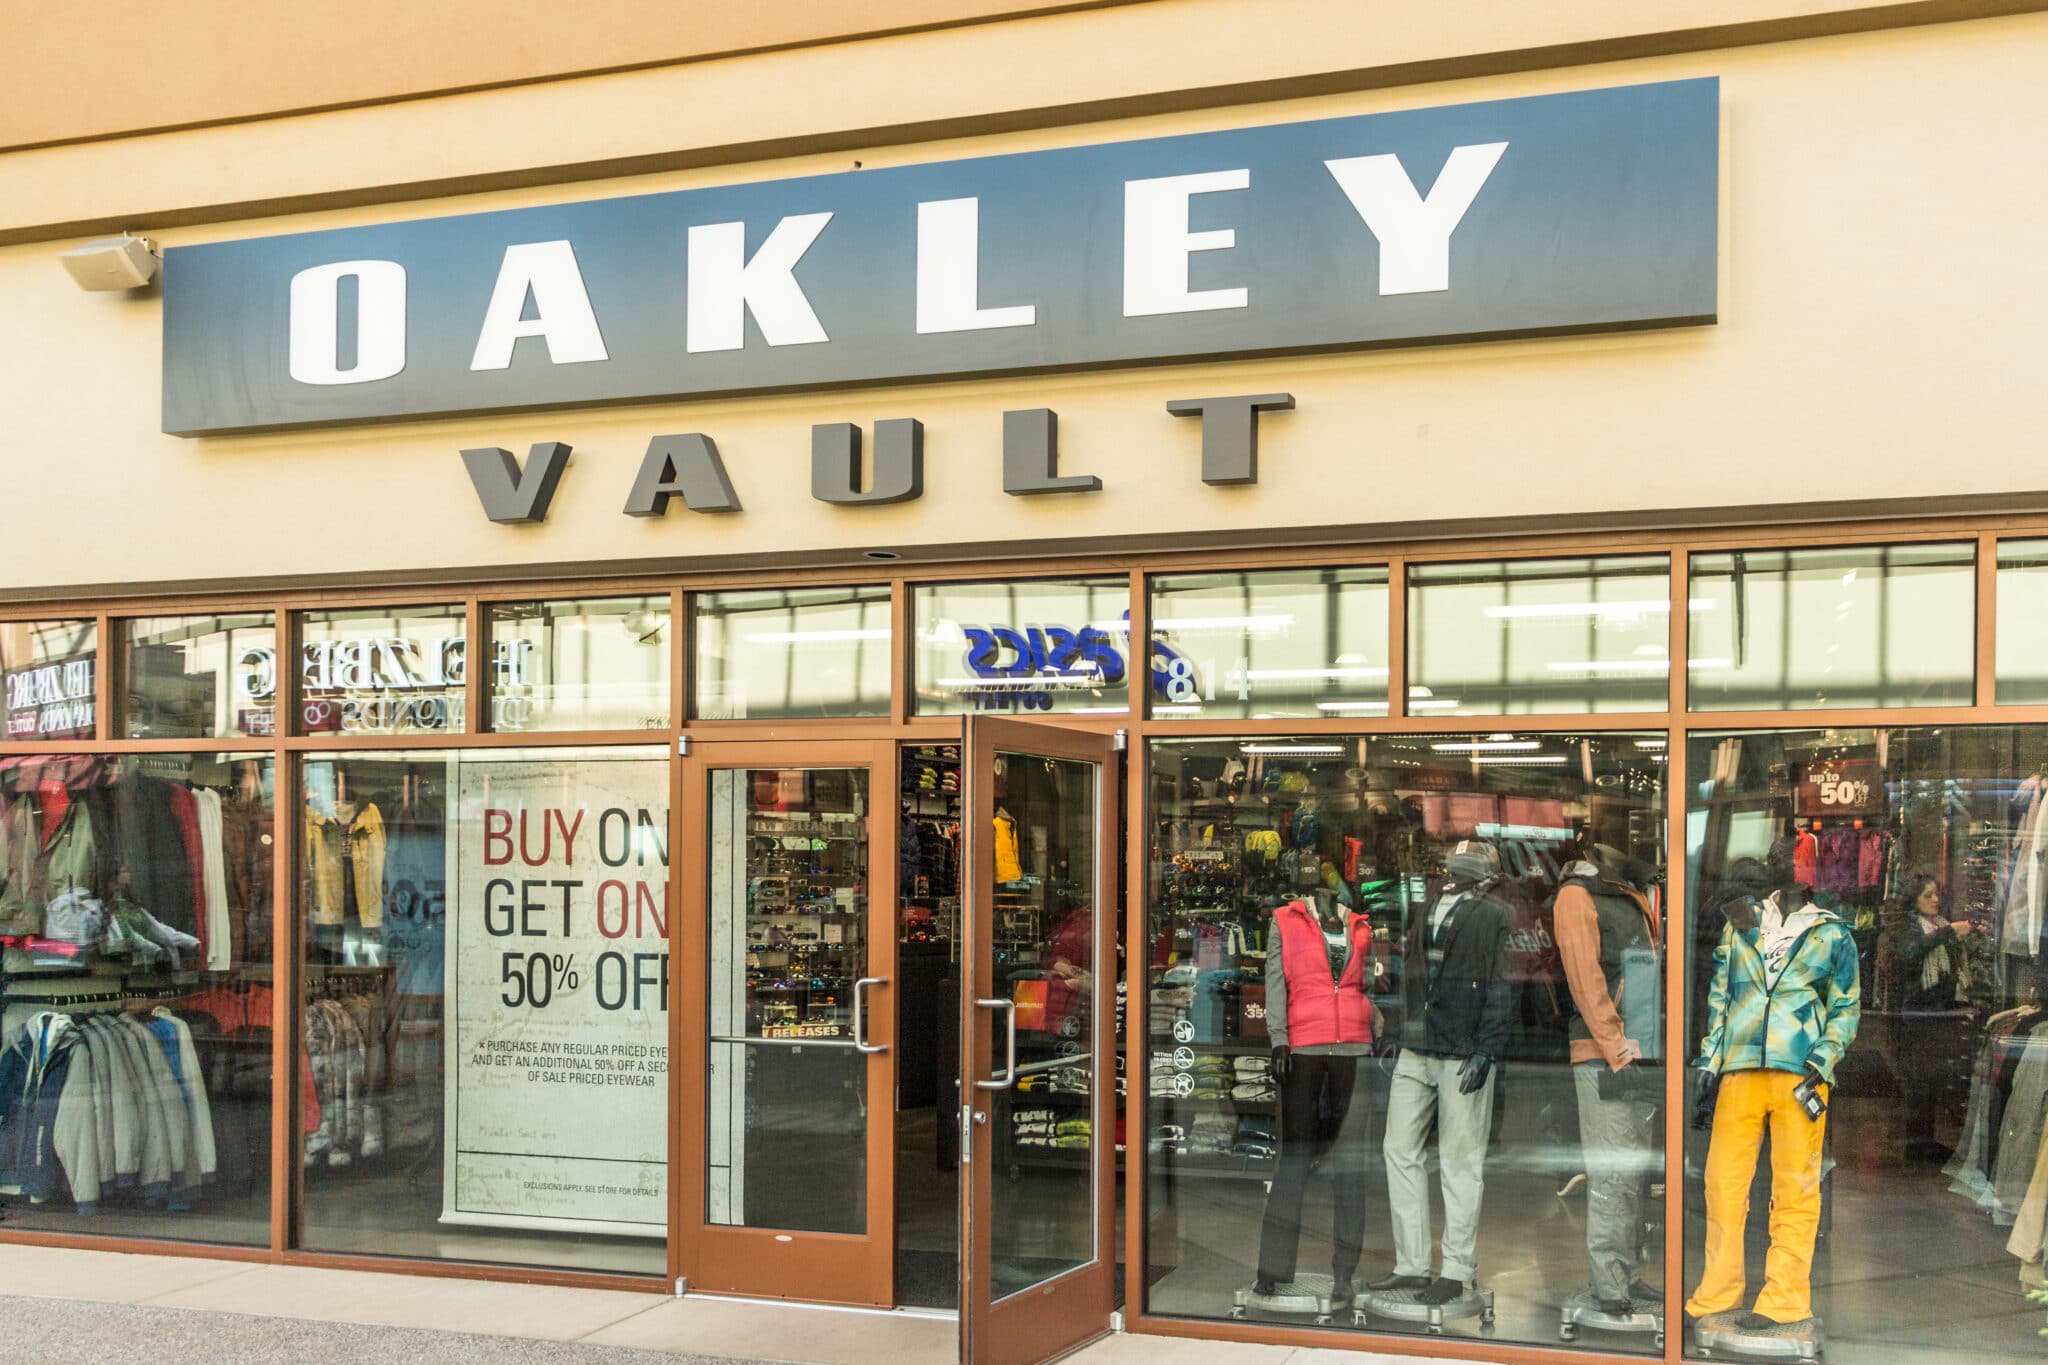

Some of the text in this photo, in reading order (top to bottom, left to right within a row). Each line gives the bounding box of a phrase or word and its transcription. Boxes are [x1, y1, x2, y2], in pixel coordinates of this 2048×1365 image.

[289, 141, 1510, 385] OAKLEY
[459, 392, 1296, 525] VAULT
[1166, 656, 1252, 701] 814
[1820, 780, 1870, 805] 50%
[484, 808, 585, 867] BUY
[484, 878, 583, 937] GET
[502, 952, 579, 1009] 50%
[487, 1040, 538, 1053] PURCHASE
[541, 1043, 561, 1054] ANY
[563, 1043, 609, 1056] REGULAR
[612, 1045, 647, 1057] PRICED
[773, 1026, 840, 1038] RELEASES
[472, 1054, 670, 1073] AND GET AN ADDITIONAL 50% OFF A SEC
[528, 1070, 655, 1087] OF SALE PRICED EYEWEAR
